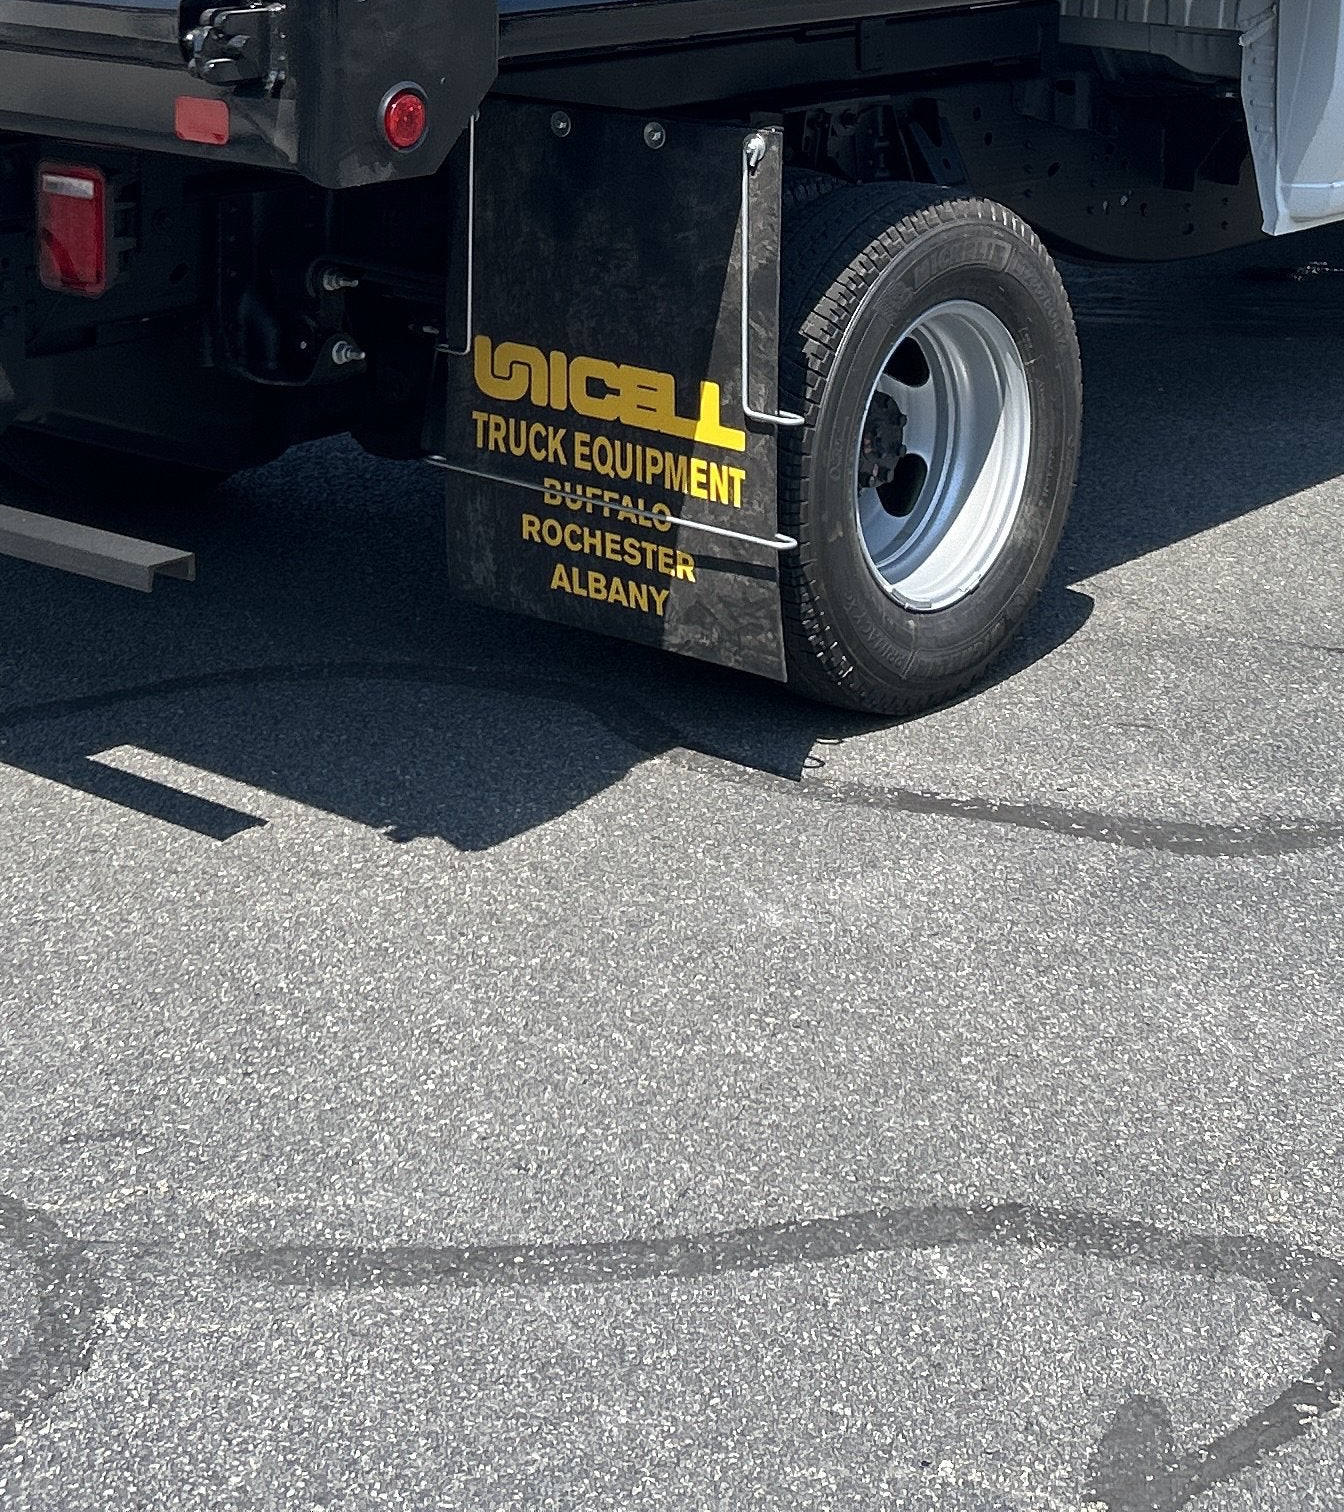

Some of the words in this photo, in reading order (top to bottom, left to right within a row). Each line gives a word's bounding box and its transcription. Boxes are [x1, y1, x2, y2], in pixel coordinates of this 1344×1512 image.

[474, 334, 746, 452] UNICELL
[472, 411, 567, 467] TRUCK
[574, 432, 746, 509] EQUIPMENT
[543, 478, 673, 533] BUFFALO
[522, 513, 697, 584] ROCHESTER
[550, 563, 670, 617] ALBANY
